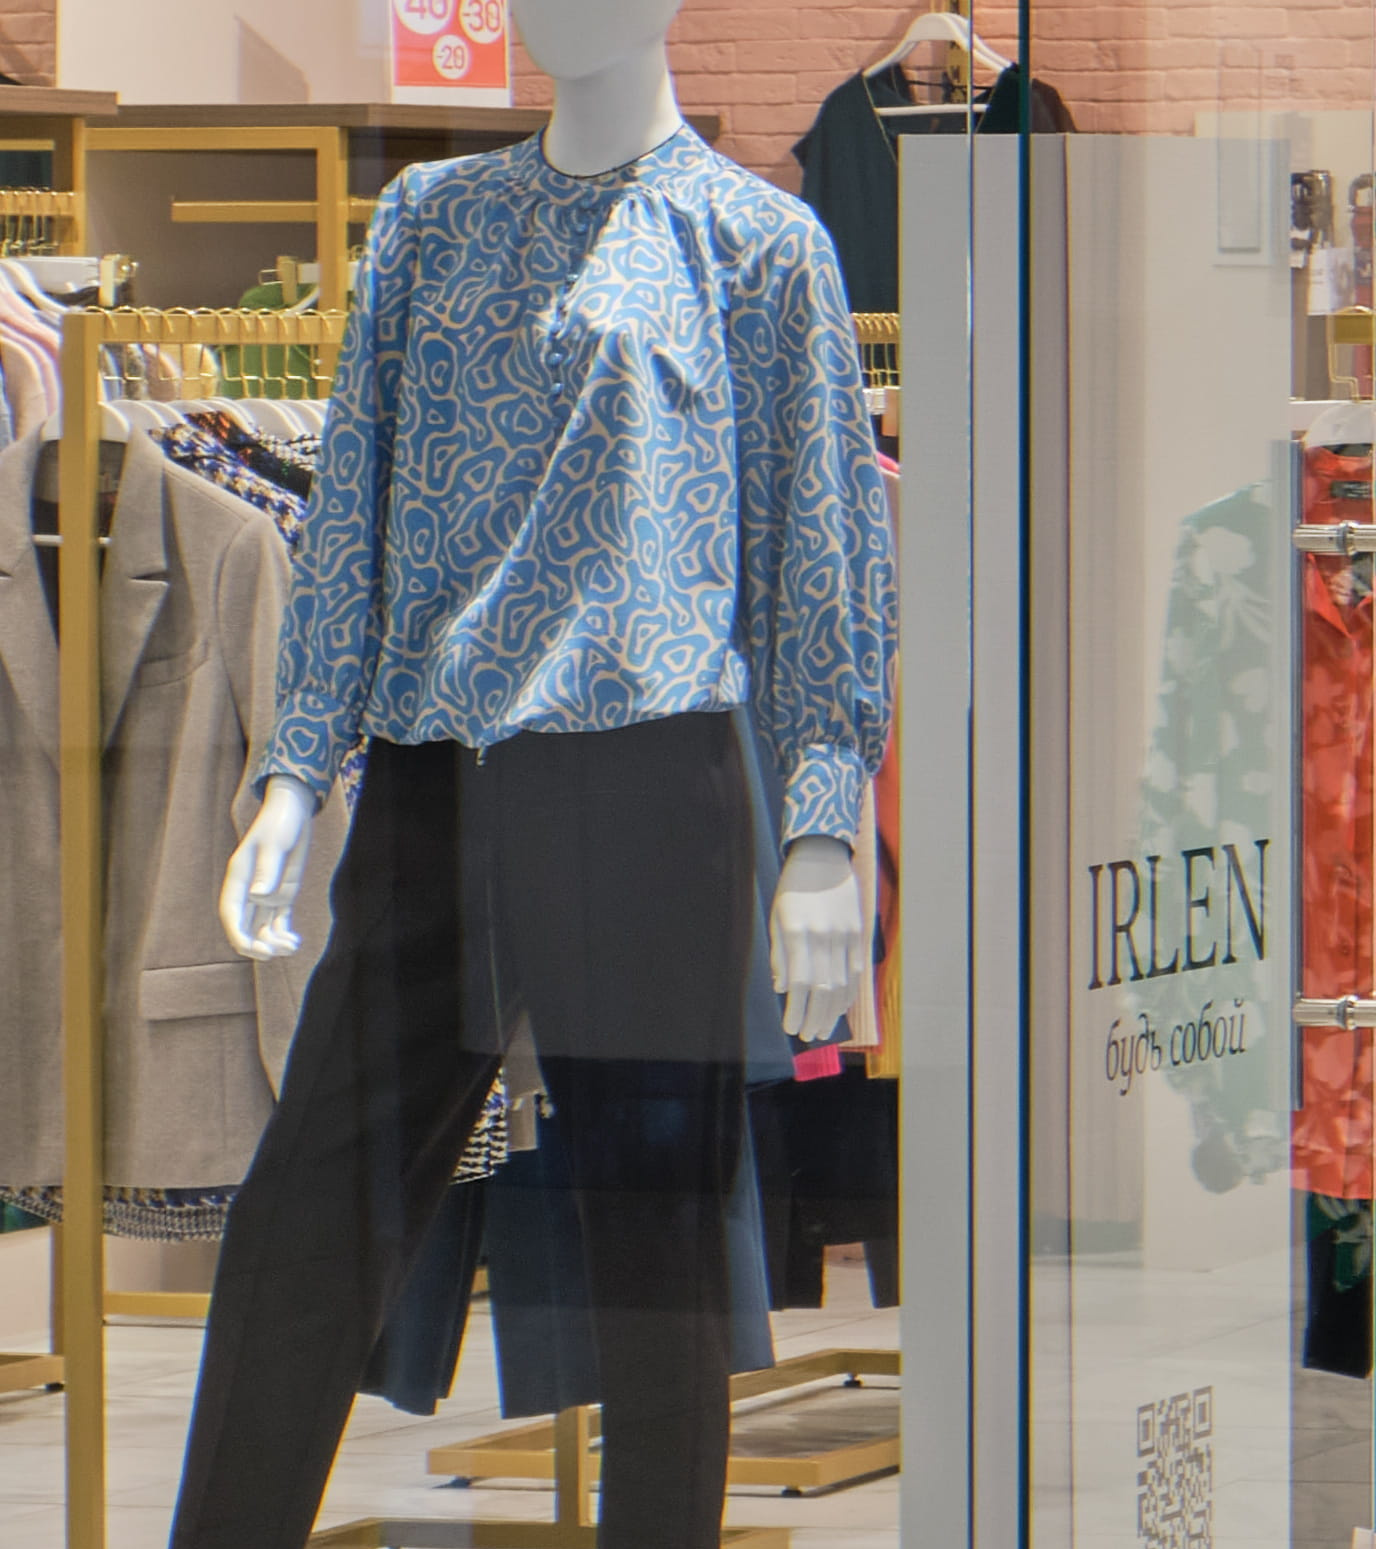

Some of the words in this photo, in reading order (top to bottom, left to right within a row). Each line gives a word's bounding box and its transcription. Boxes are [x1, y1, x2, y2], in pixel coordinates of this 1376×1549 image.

[1088, 839, 1270, 990] IRLEN
[1106, 1012, 1162, 1096] будь
[1170, 998, 1247, 1067] собой
